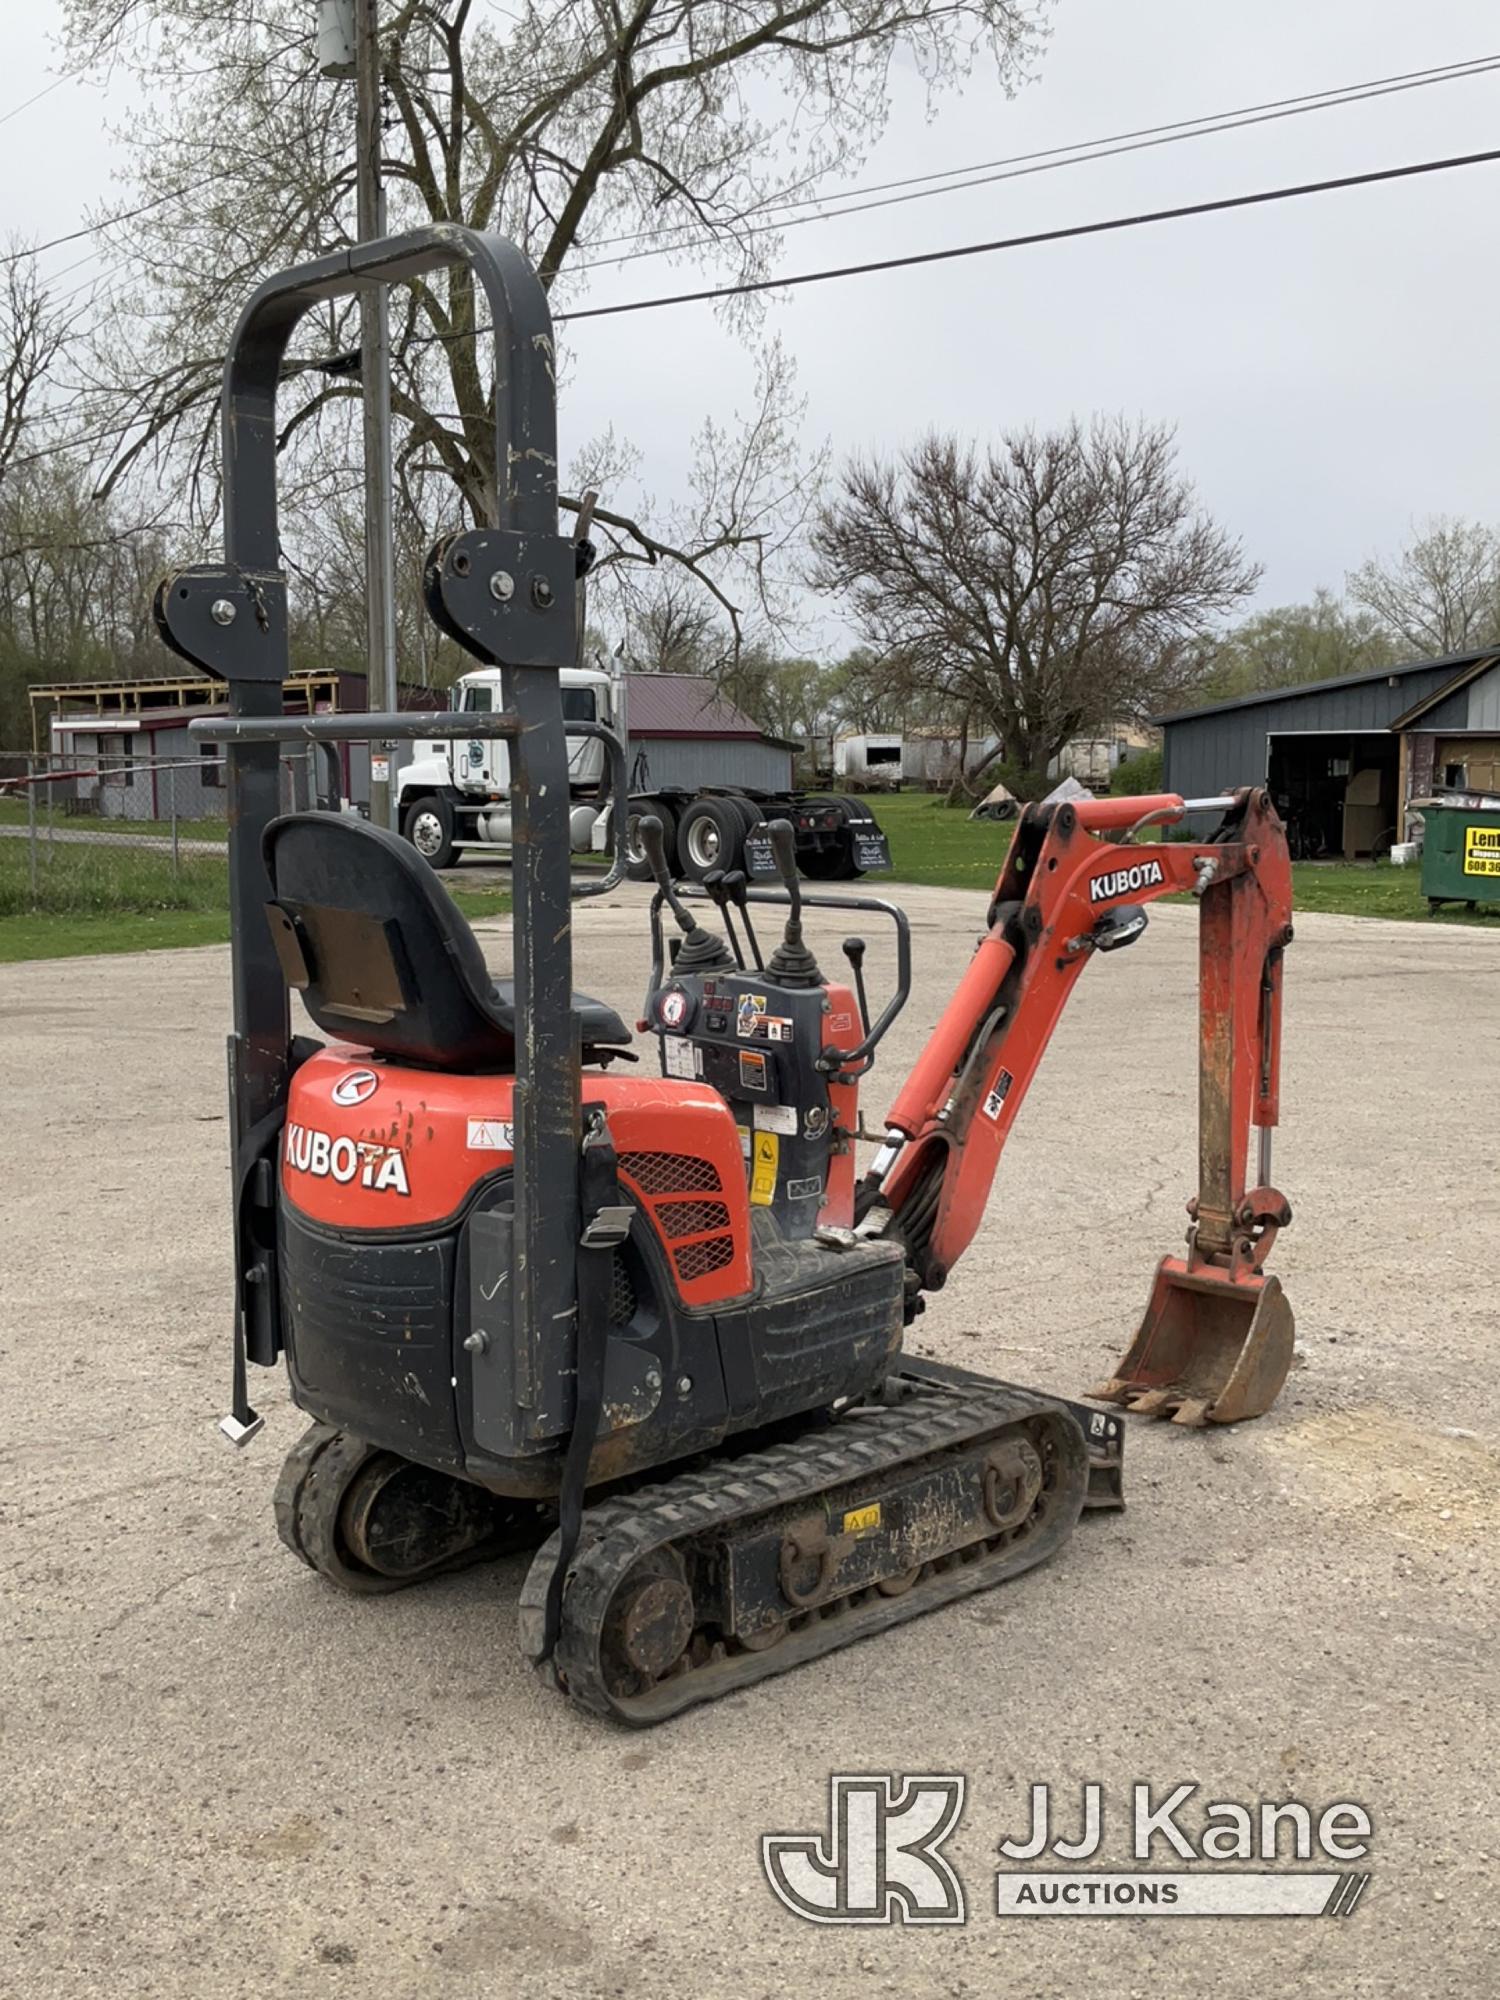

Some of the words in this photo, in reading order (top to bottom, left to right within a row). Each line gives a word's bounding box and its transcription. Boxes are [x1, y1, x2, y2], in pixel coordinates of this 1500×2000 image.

[1090, 860, 1163, 901] KUBOTA
[1467, 861, 1486, 871] 608
[286, 1122, 410, 1195] KUBOTA
